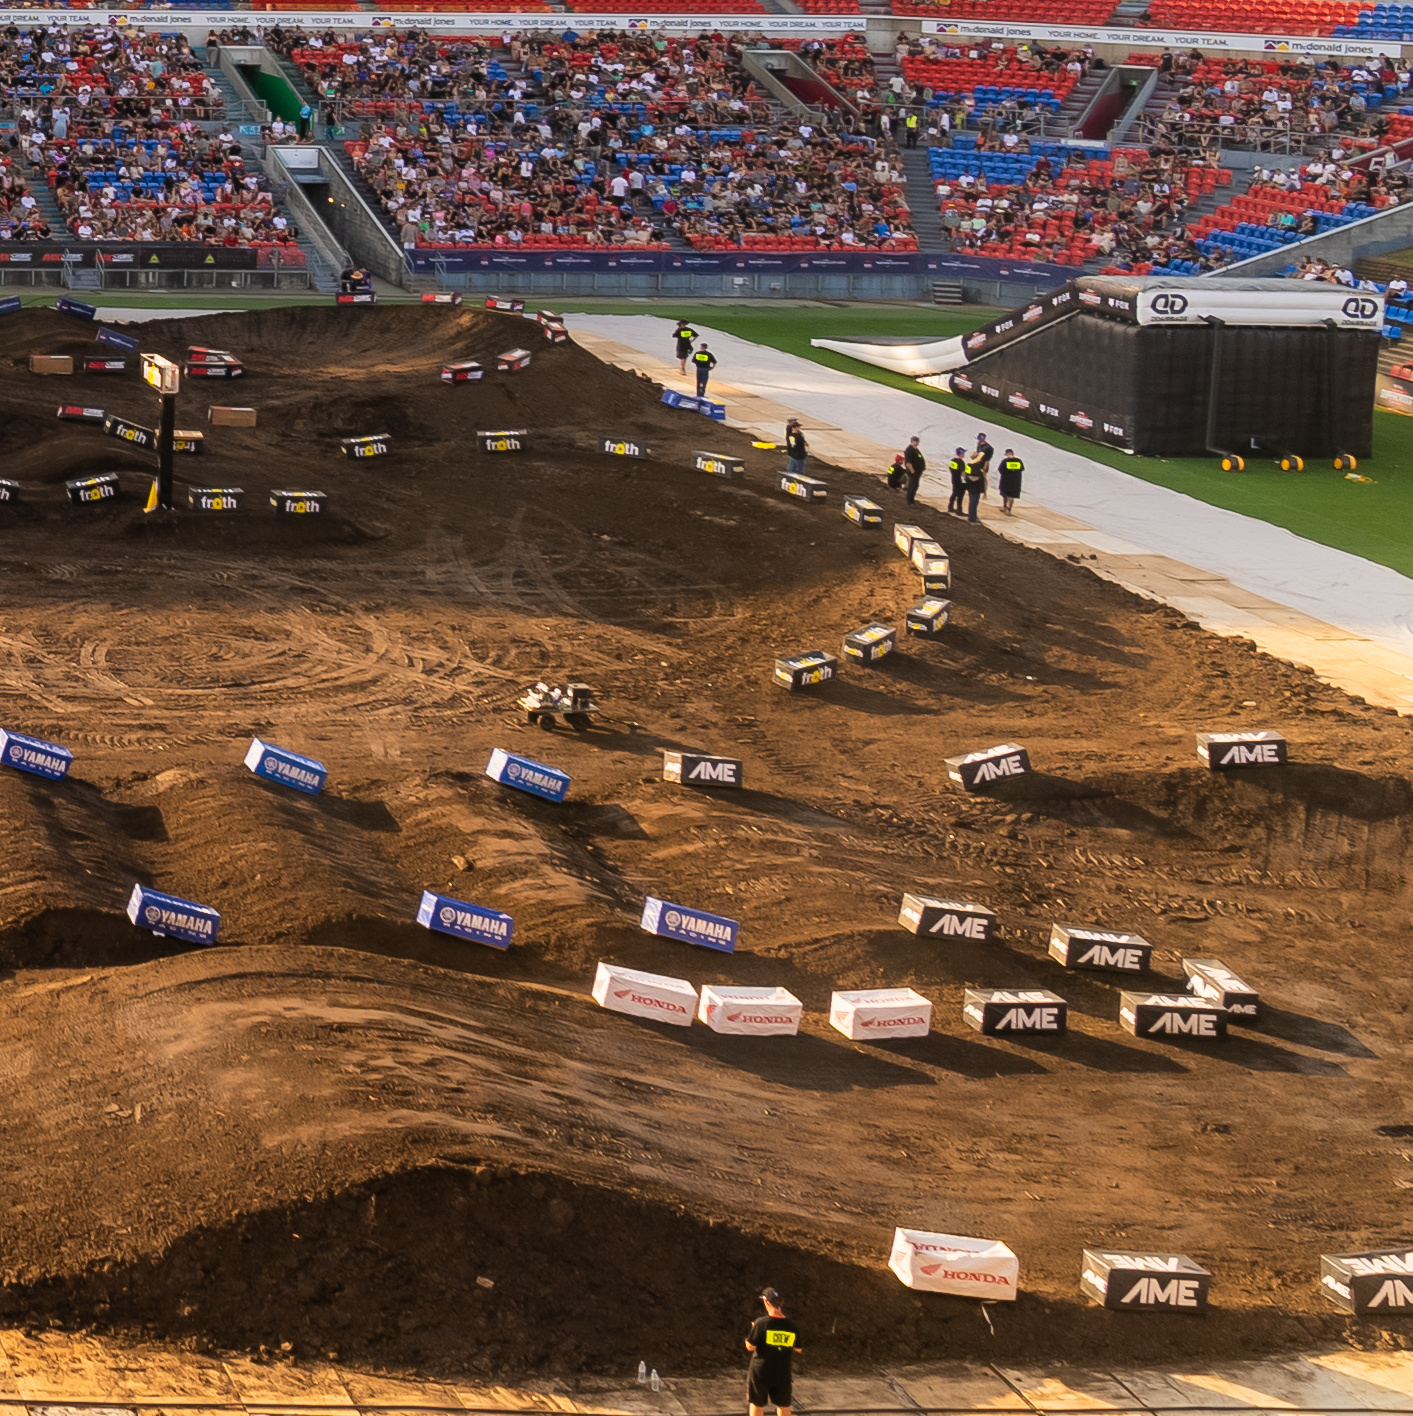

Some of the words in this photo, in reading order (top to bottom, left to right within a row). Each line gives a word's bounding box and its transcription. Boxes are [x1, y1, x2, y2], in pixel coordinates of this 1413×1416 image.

[1107, 33, 1131, 41] YOUR
[1174, 37, 1199, 45] YOUR
[1344, 44, 1374, 54] jones
[116, 423, 147, 444] froth
[354, 441, 388, 458] froth
[486, 438, 521, 452] froth
[604, 440, 639, 456] froth
[696, 458, 726, 474] froth
[79, 485, 114, 501] froth
[201, 494, 237, 509] froth
[285, 498, 320, 514] froth
[23, 750, 66, 773] YAMAHA
[1220, 744, 1279, 764] AME
[277, 763, 320, 787] YAMAHA
[520, 768, 563, 791] YAMAHA
[688, 761, 736, 783] AME
[974, 755, 1025, 783] AME
[161, 908, 212, 934] YAMAHA
[455, 911, 508, 936] YAMAHA
[681, 914, 732, 942] YAMAHA
[930, 914, 987, 939] AME
[1077, 945, 1143, 970] AME
[631, 993, 688, 1014] HONDA
[742, 1014, 794, 1024] HONDA
[876, 1015, 925, 1026] HONDA
[995, 1008, 1058, 1029] AME
[1149, 1009, 1216, 1036] AME
[942, 1269, 1010, 1287] HONDA
[1121, 1278, 1197, 1306] AME
[1367, 1278, 1413, 1307] AM
